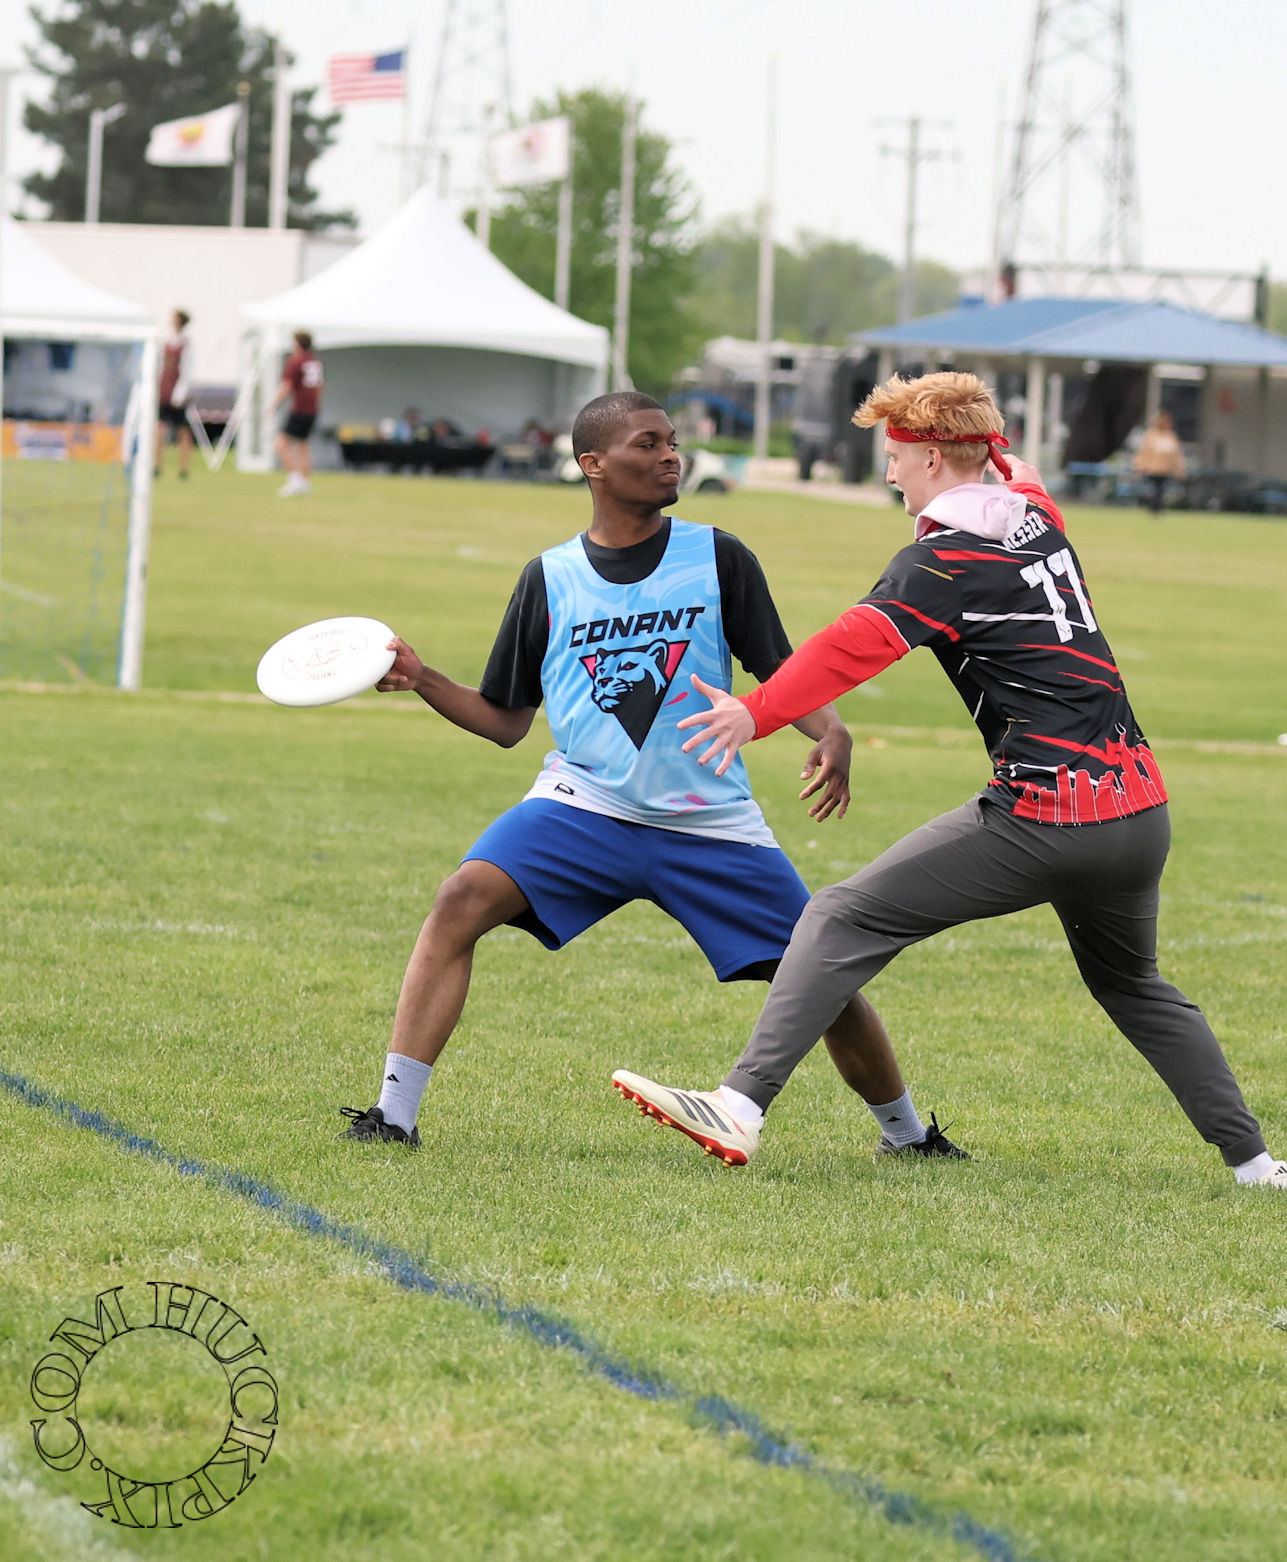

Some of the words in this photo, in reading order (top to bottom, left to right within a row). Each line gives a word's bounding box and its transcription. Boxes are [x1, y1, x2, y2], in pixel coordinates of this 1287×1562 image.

[1002, 511, 1049, 550] ESSER
[1019, 548, 1098, 643] 77
[569, 606, 706, 648] CONANT
